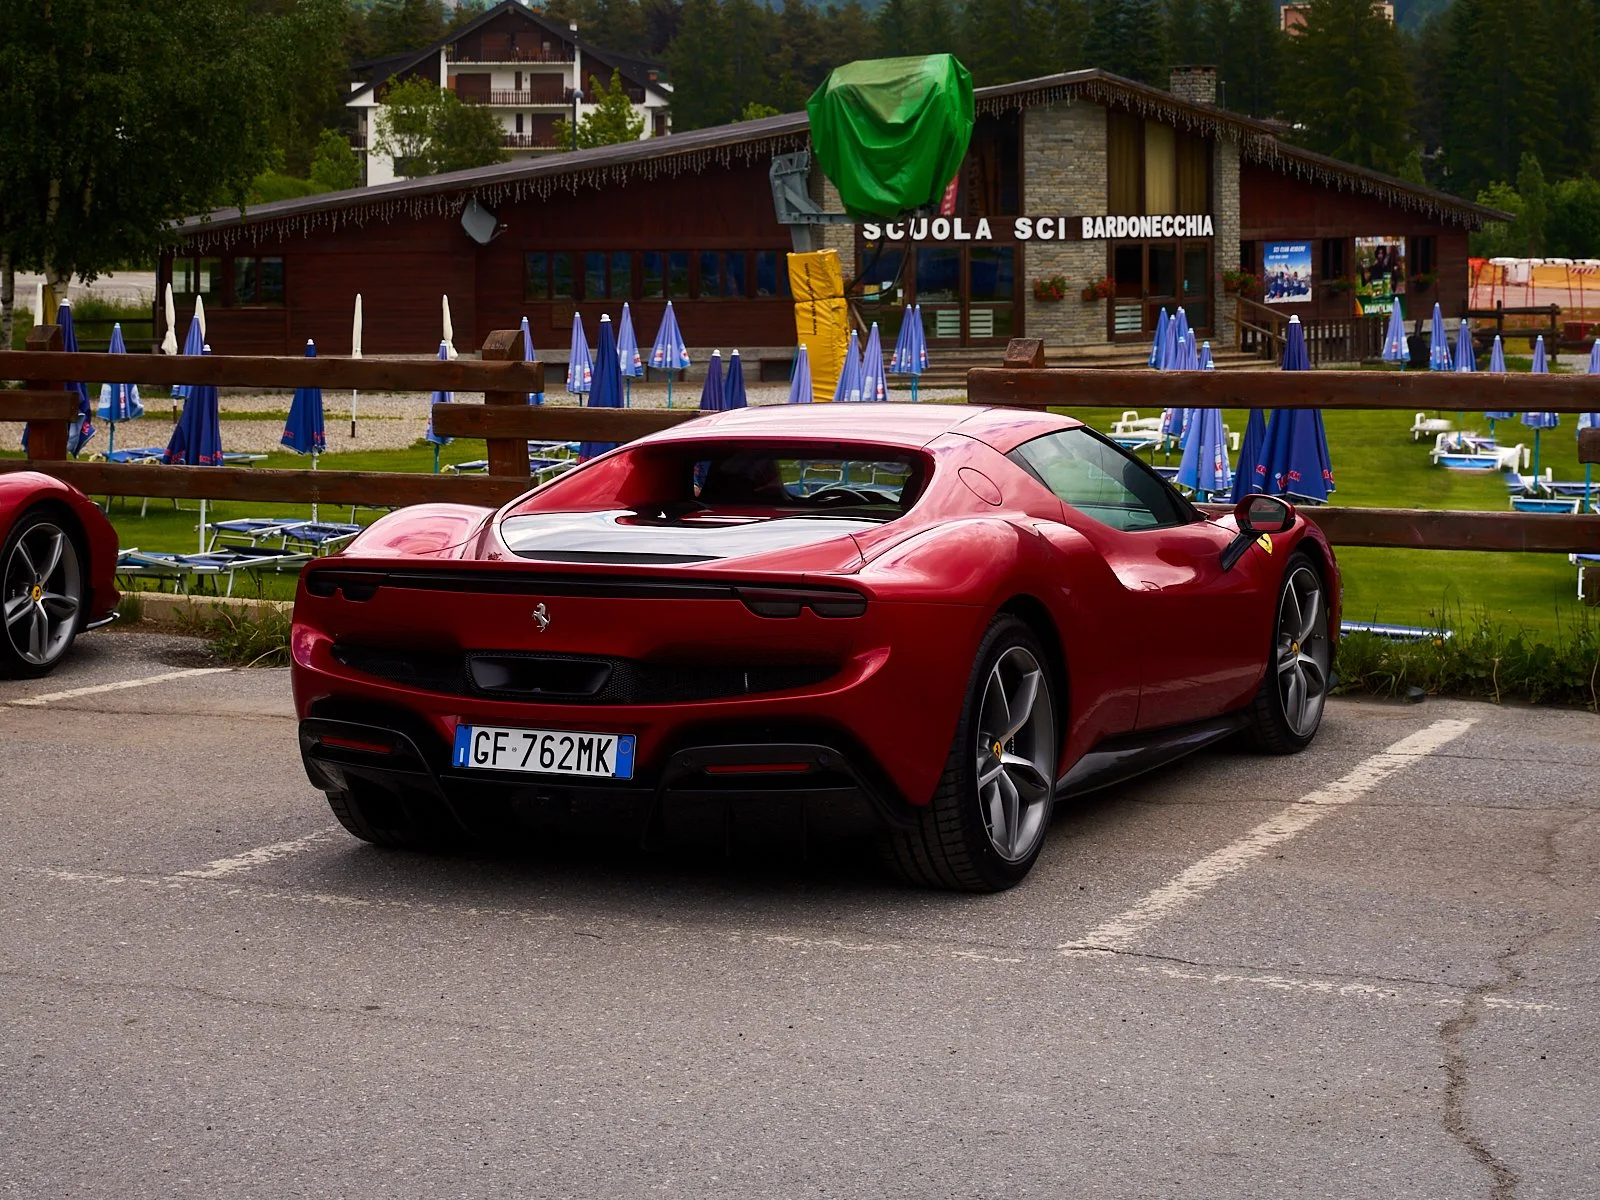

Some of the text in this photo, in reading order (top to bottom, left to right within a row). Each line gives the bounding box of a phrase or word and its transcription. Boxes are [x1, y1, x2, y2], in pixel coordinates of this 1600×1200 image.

[862, 214, 1214, 241] SCUOLA SCI BARDONECCHIA
[1364, 303, 1394, 315] DIAVOLIN
[473, 730, 614, 773] GF 762MK
